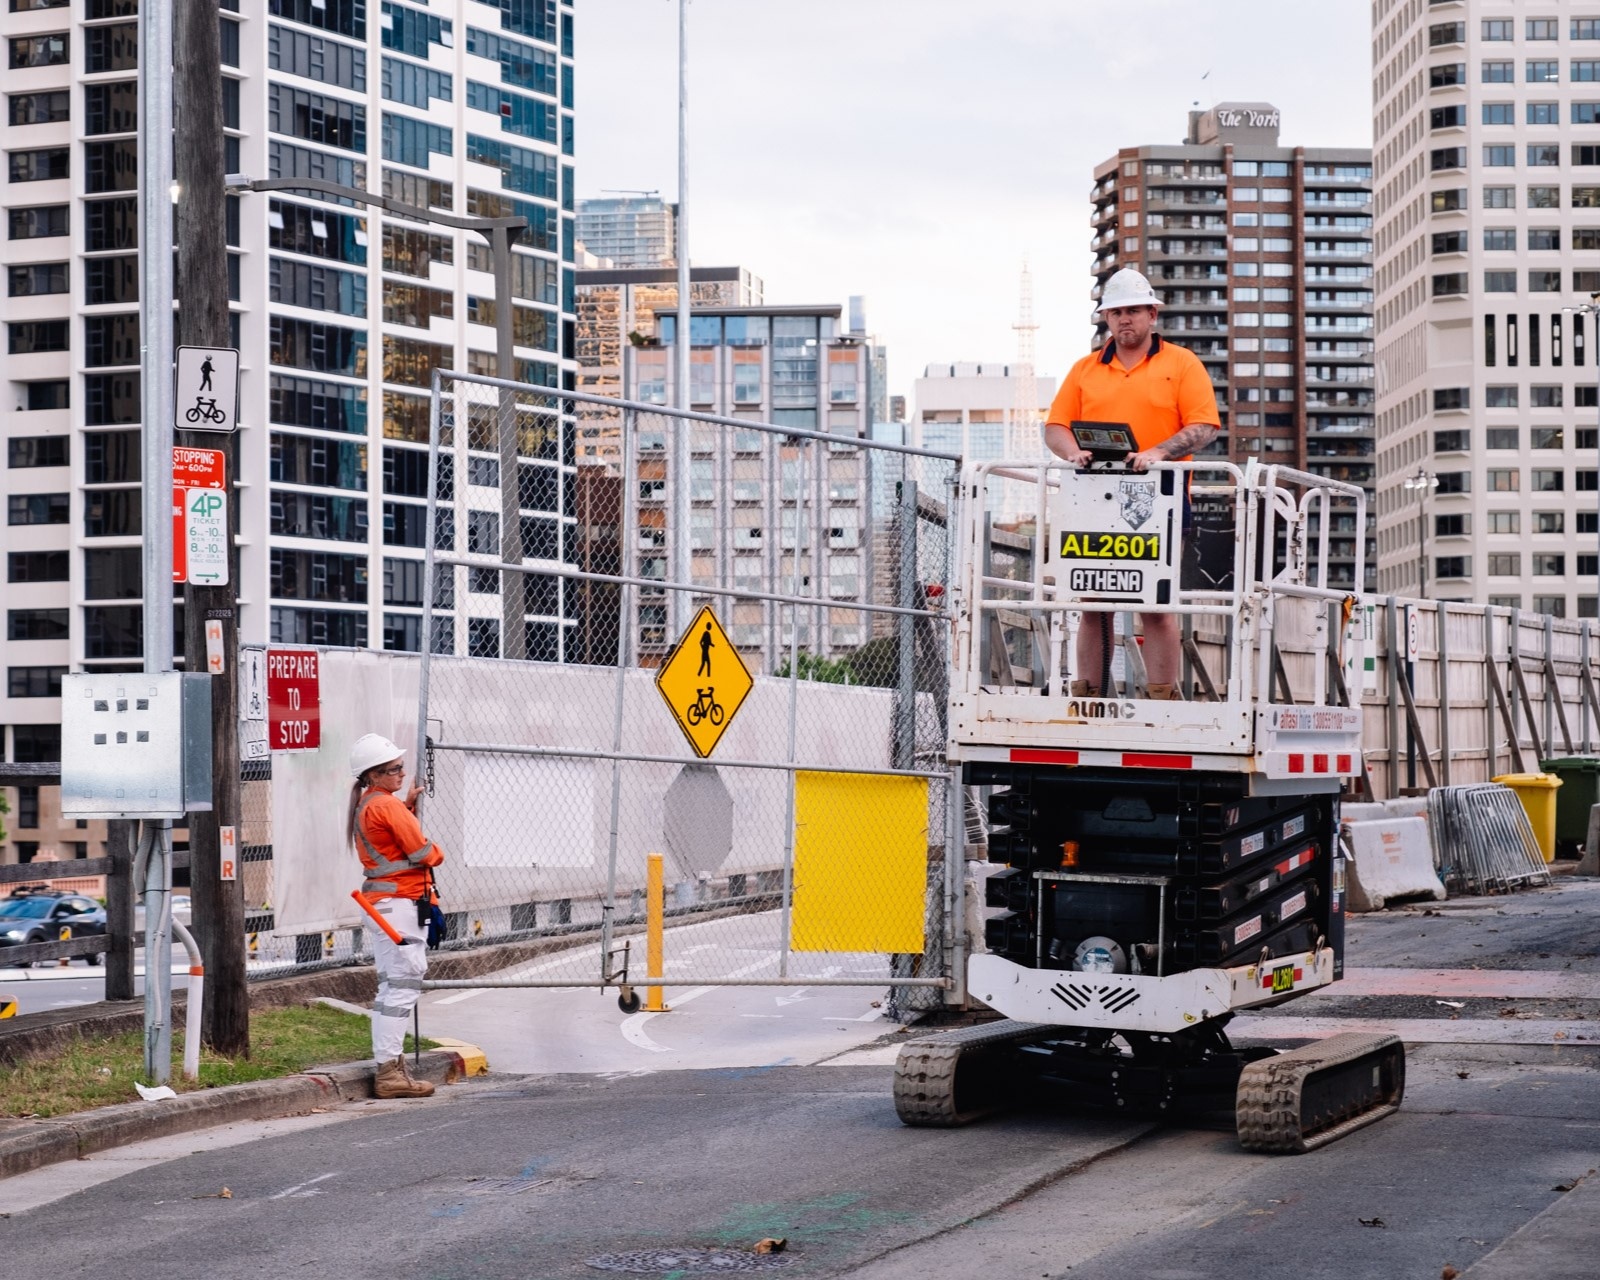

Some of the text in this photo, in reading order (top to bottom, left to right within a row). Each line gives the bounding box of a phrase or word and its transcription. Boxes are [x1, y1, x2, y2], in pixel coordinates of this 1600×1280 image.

[1218, 109, 1279, 127] The York
[174, 450, 215, 465] STOPPING
[190, 496, 223, 517] 4P
[1061, 534, 1159, 558] AL2601
[1072, 570, 1141, 591] ATHENA
[269, 655, 317, 679] PREPARE
[287, 687, 300, 711] TO
[280, 720, 310, 744] STOP
[251, 743, 264, 755] END
[222, 830, 233, 845] H
[222, 861, 233, 878] R
